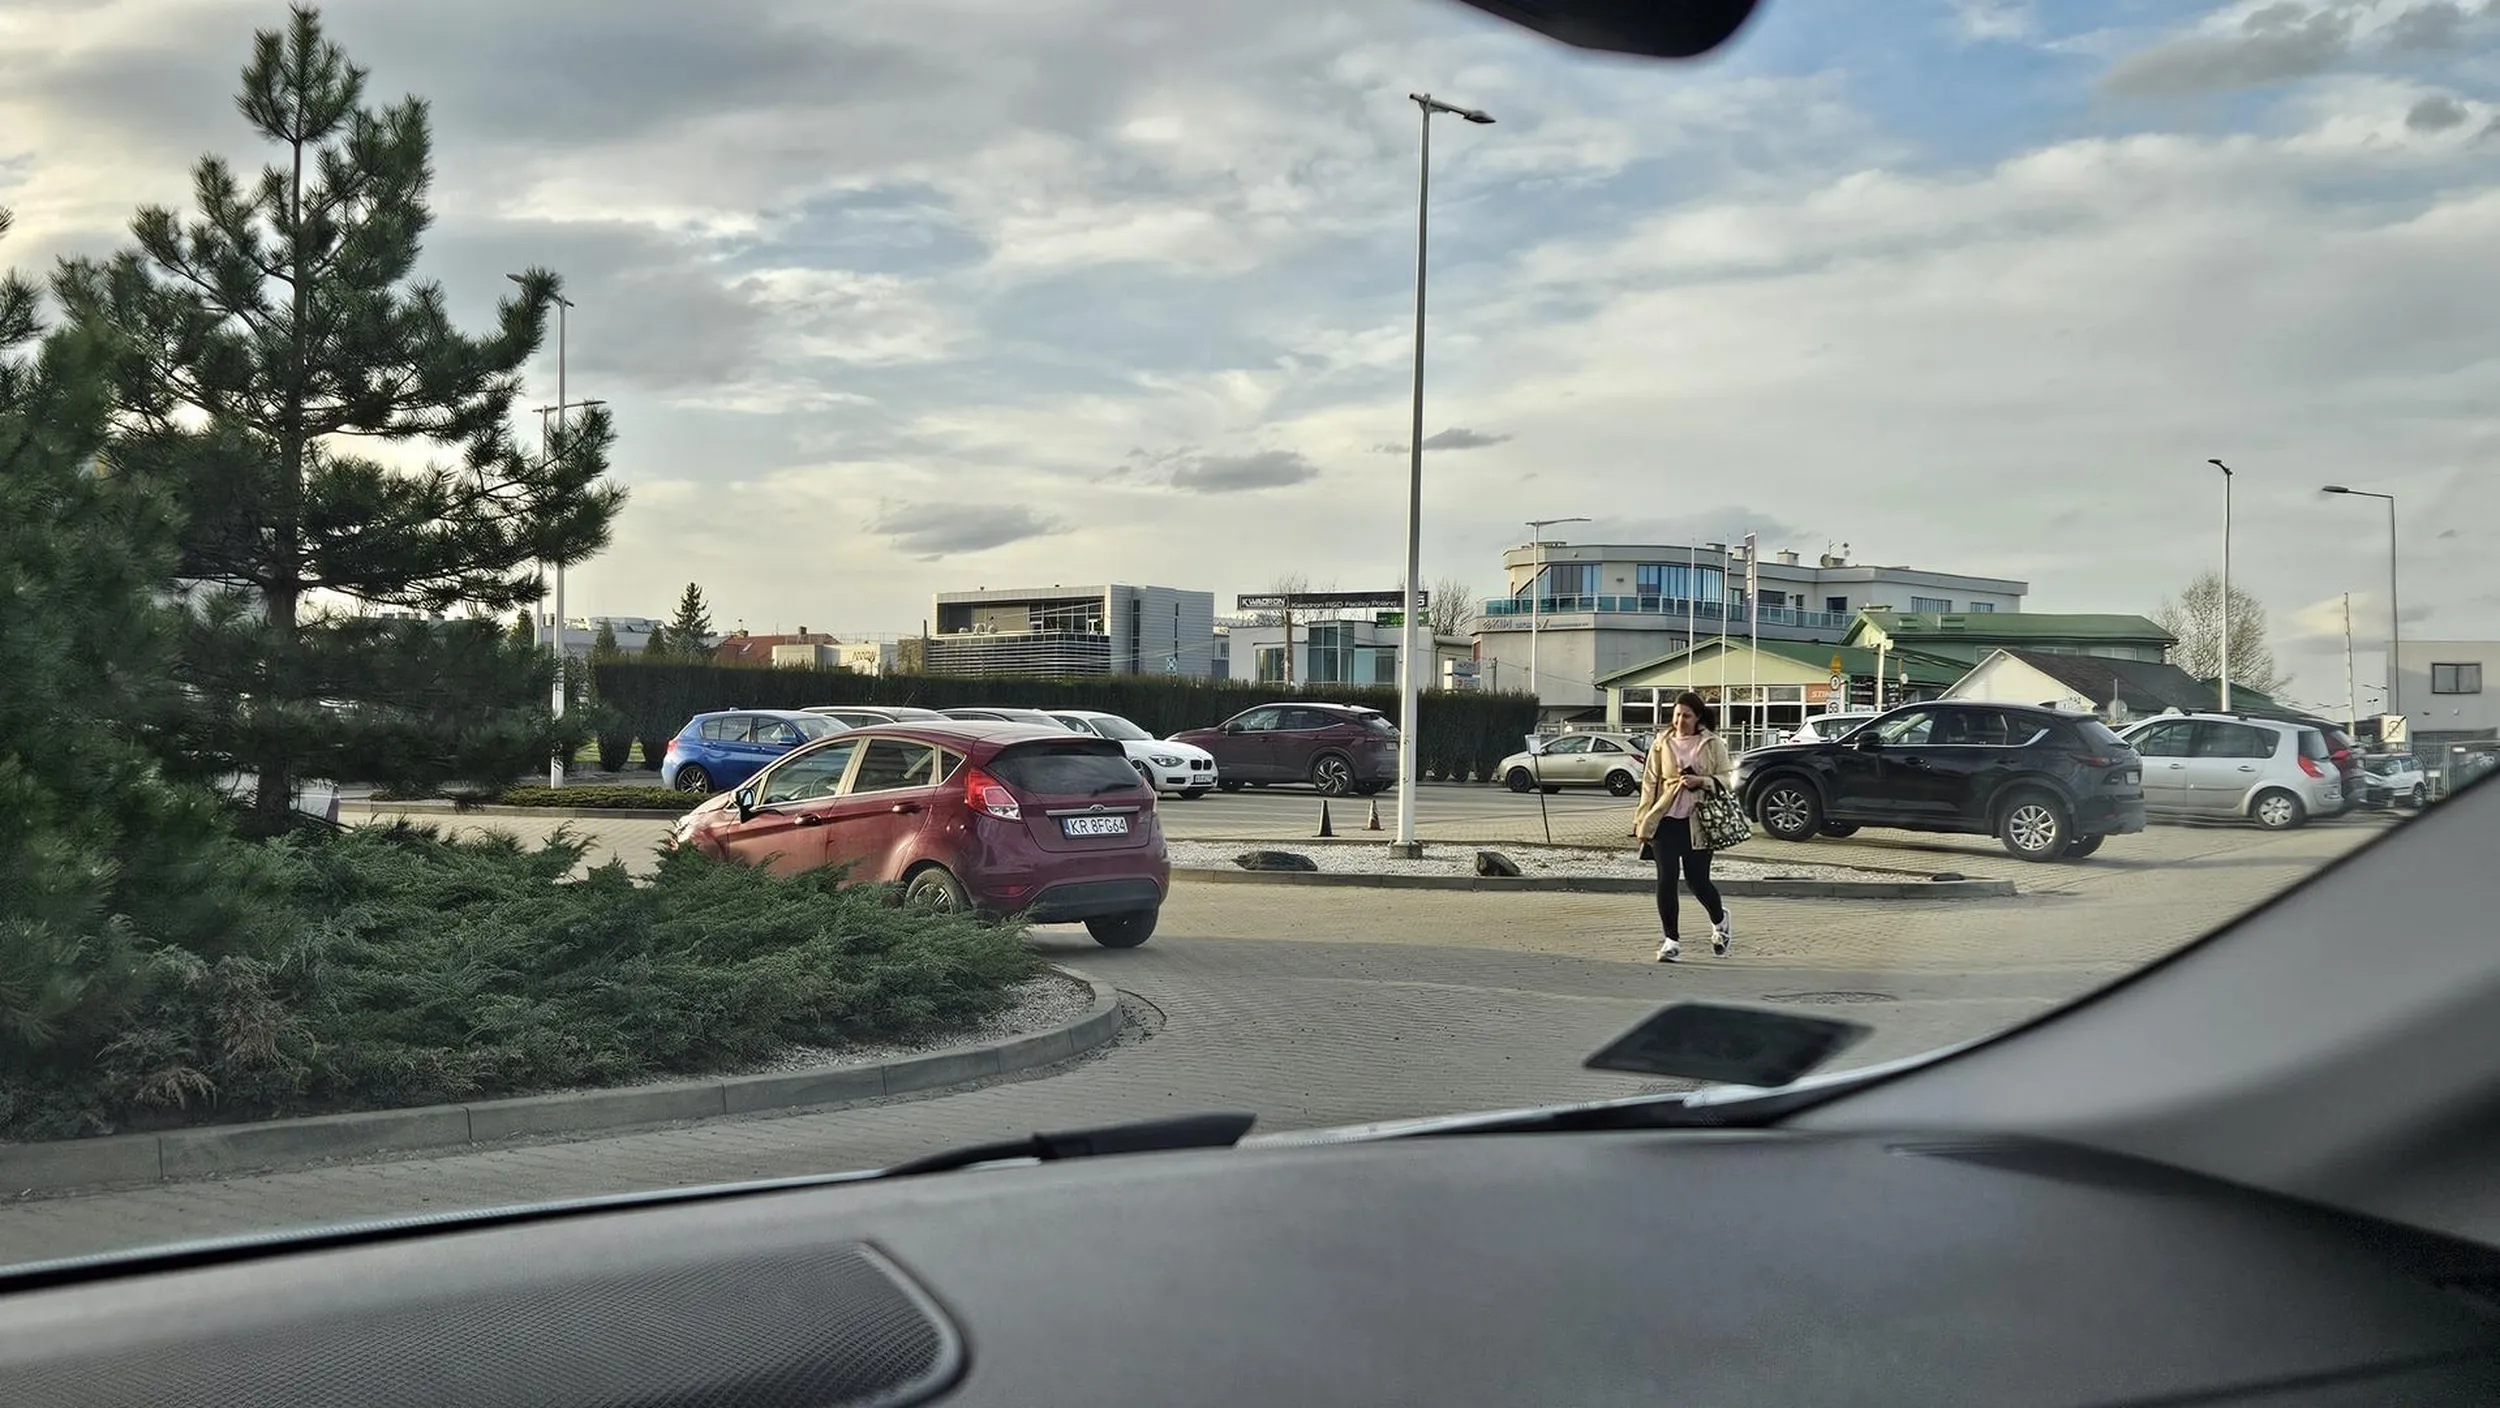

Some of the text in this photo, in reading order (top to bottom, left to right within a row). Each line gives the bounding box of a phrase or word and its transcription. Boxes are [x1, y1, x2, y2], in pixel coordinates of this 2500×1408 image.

[1241, 598, 1285, 607] KWADRON
[1070, 818, 1126, 833] KR 8FG64
